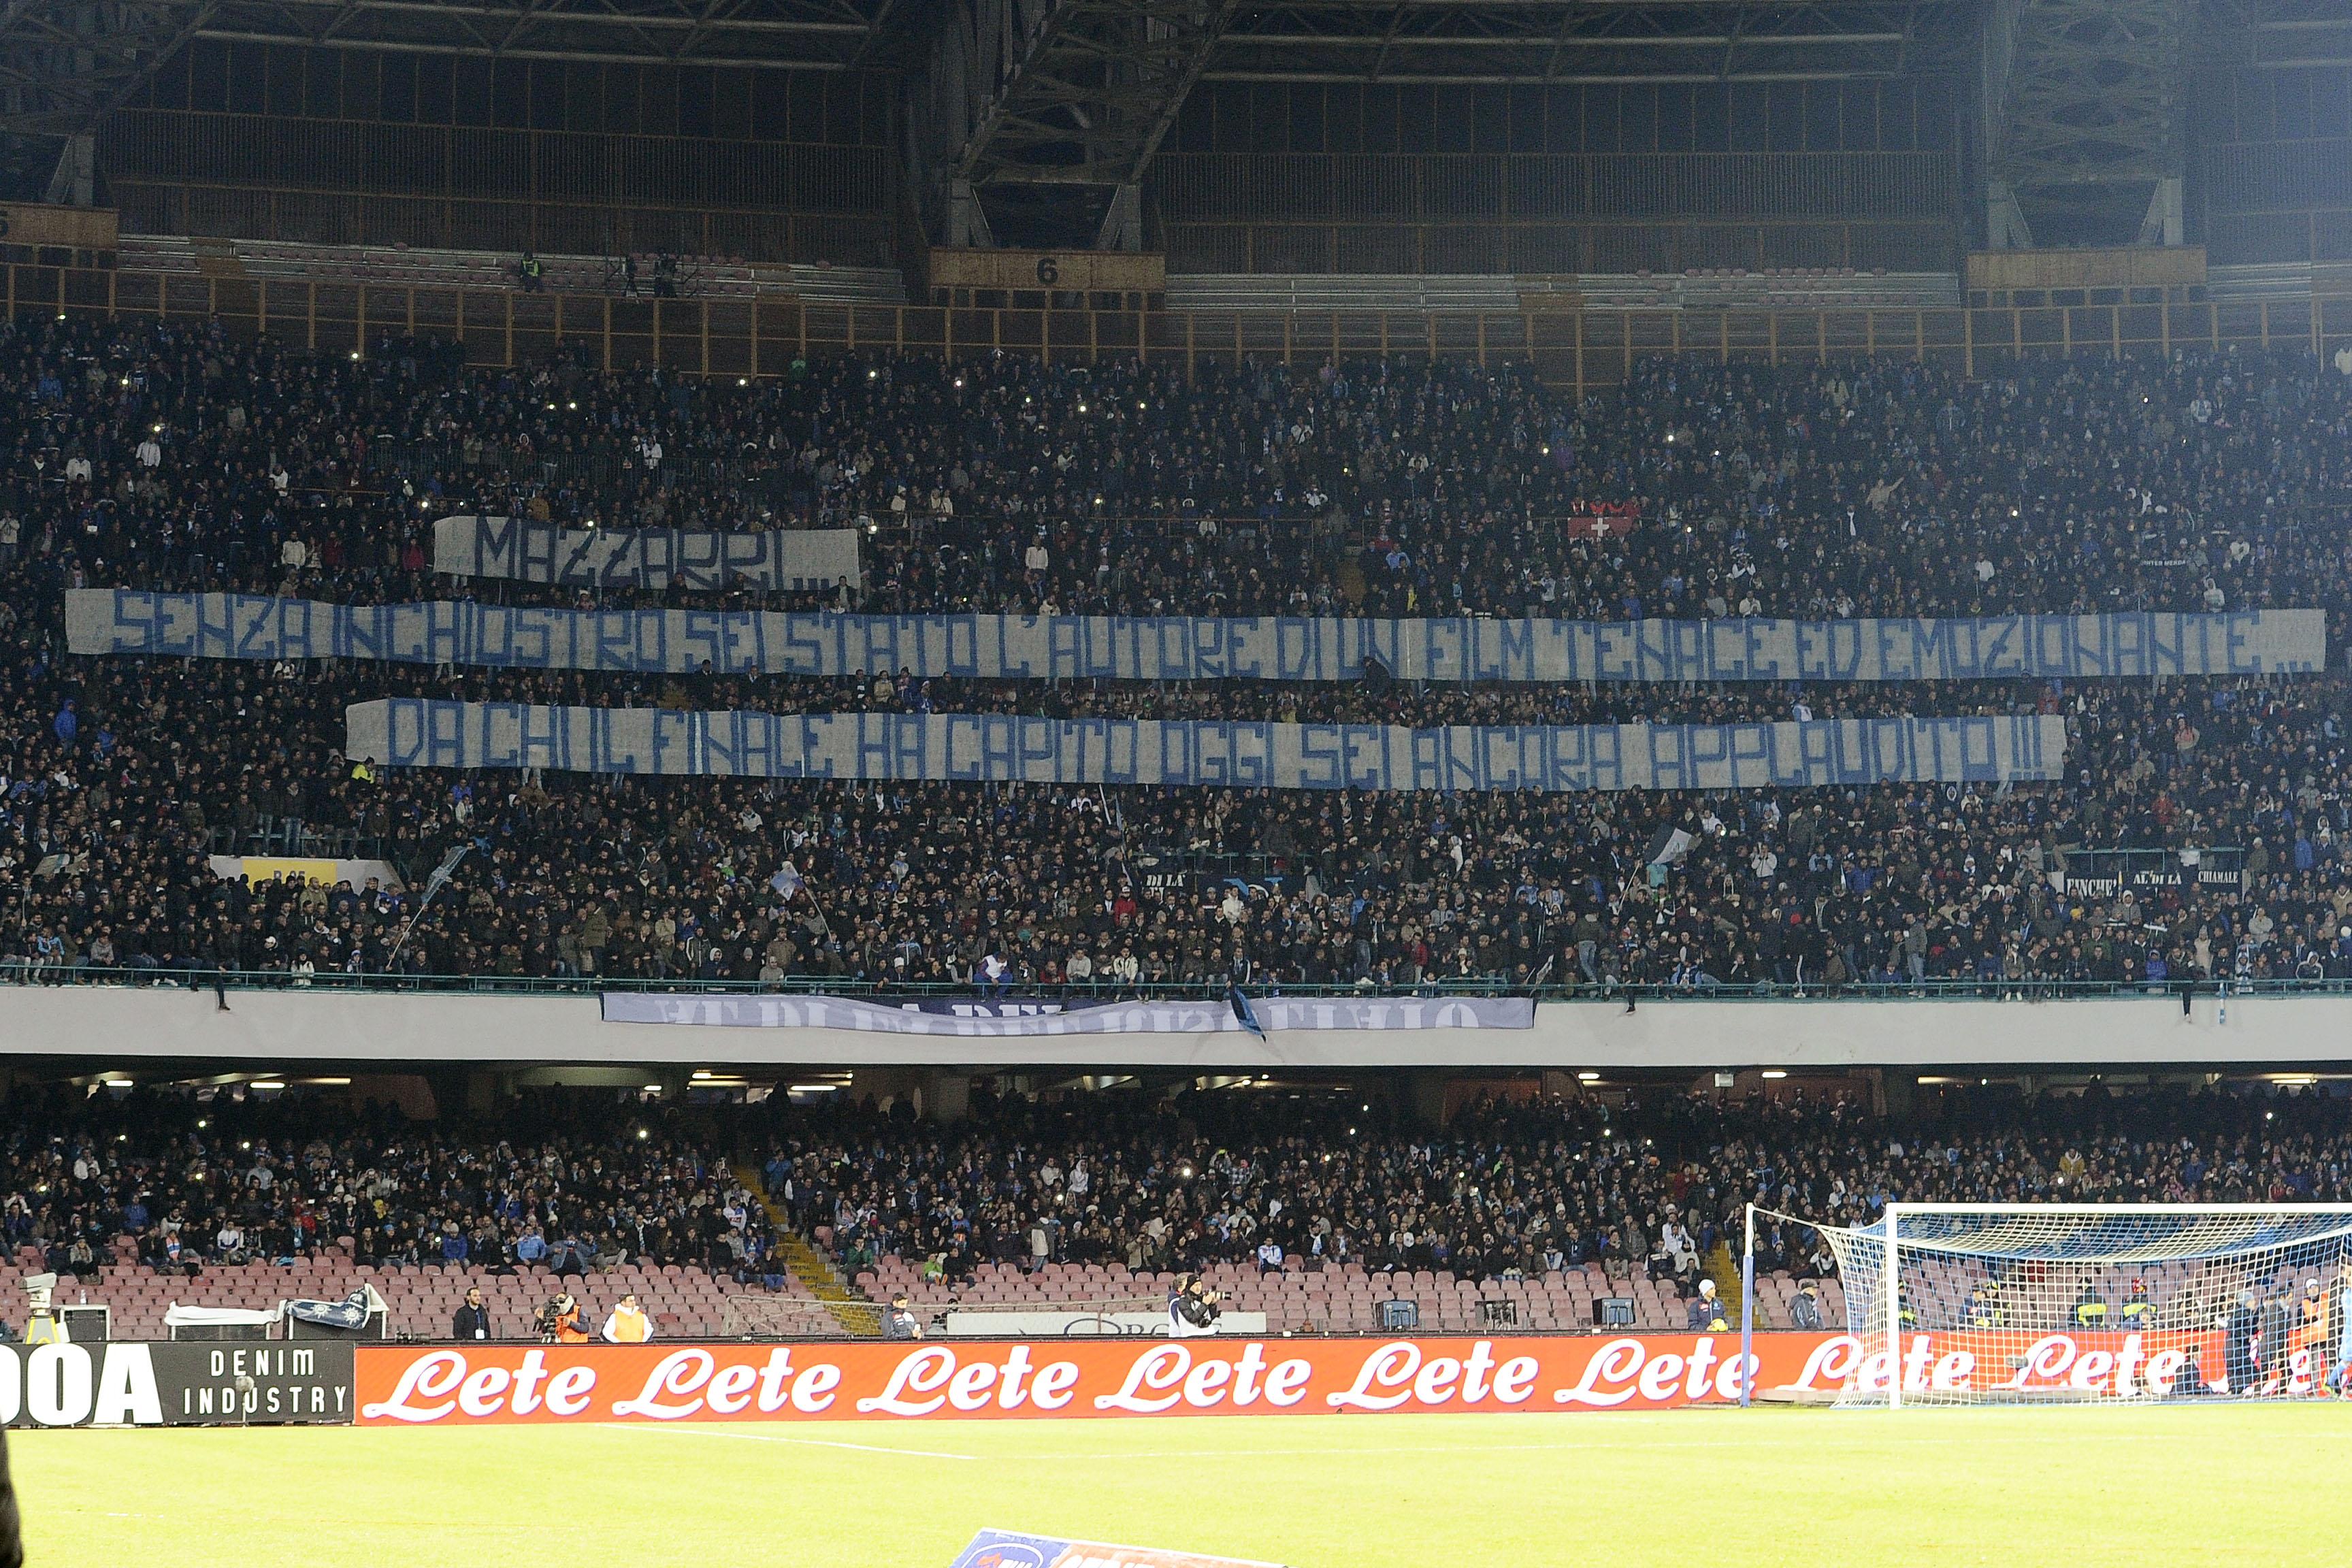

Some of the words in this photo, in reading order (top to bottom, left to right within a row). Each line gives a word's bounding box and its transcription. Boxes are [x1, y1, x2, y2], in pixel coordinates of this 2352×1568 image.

[1037, 258, 1058, 284] 6
[113, 590, 310, 657] SENZA
[331, 602, 667, 673] INCHIOSTRO
[687, 610, 764, 674] SEI
[785, 612, 977, 679] STATO
[999, 615, 1260, 679] L'AUTORE
[1275, 617, 1322, 679] DI
[1337, 617, 1399, 681] UN
[1426, 617, 1535, 681] FILM
[1553, 617, 1778, 681] TENACE
[1795, 617, 1861, 681] ED
[388, 698, 463, 768] DA
[483, 702, 570, 770] CHI
[590, 707, 635, 773] IL
[653, 708, 833, 779] FINALE
[858, 713, 926, 780] HA
[947, 713, 1138, 783] CAPITO
[1160, 720, 1273, 787] OGGI
[1301, 724, 1390, 790] SEI
[1411, 723, 1621, 791] ANCORA
[2198, 870, 2238, 883] CHIAMALE
[211, 1350, 315, 1377] DENIM
[362, 1349, 596, 1423] Lete
[612, 1348, 841, 1420] Lete
[856, 1345, 1079, 1416] Lete
[1094, 1342, 1311, 1413] Lete
[1326, 1340, 1539, 1410] Lete
[1554, 1337, 1760, 1407] Lete
[1775, 1335, 1975, 1392] Lete
[1990, 1333, 2186, 1397] Lete
[185, 1386, 346, 1415] INDUSTRY
